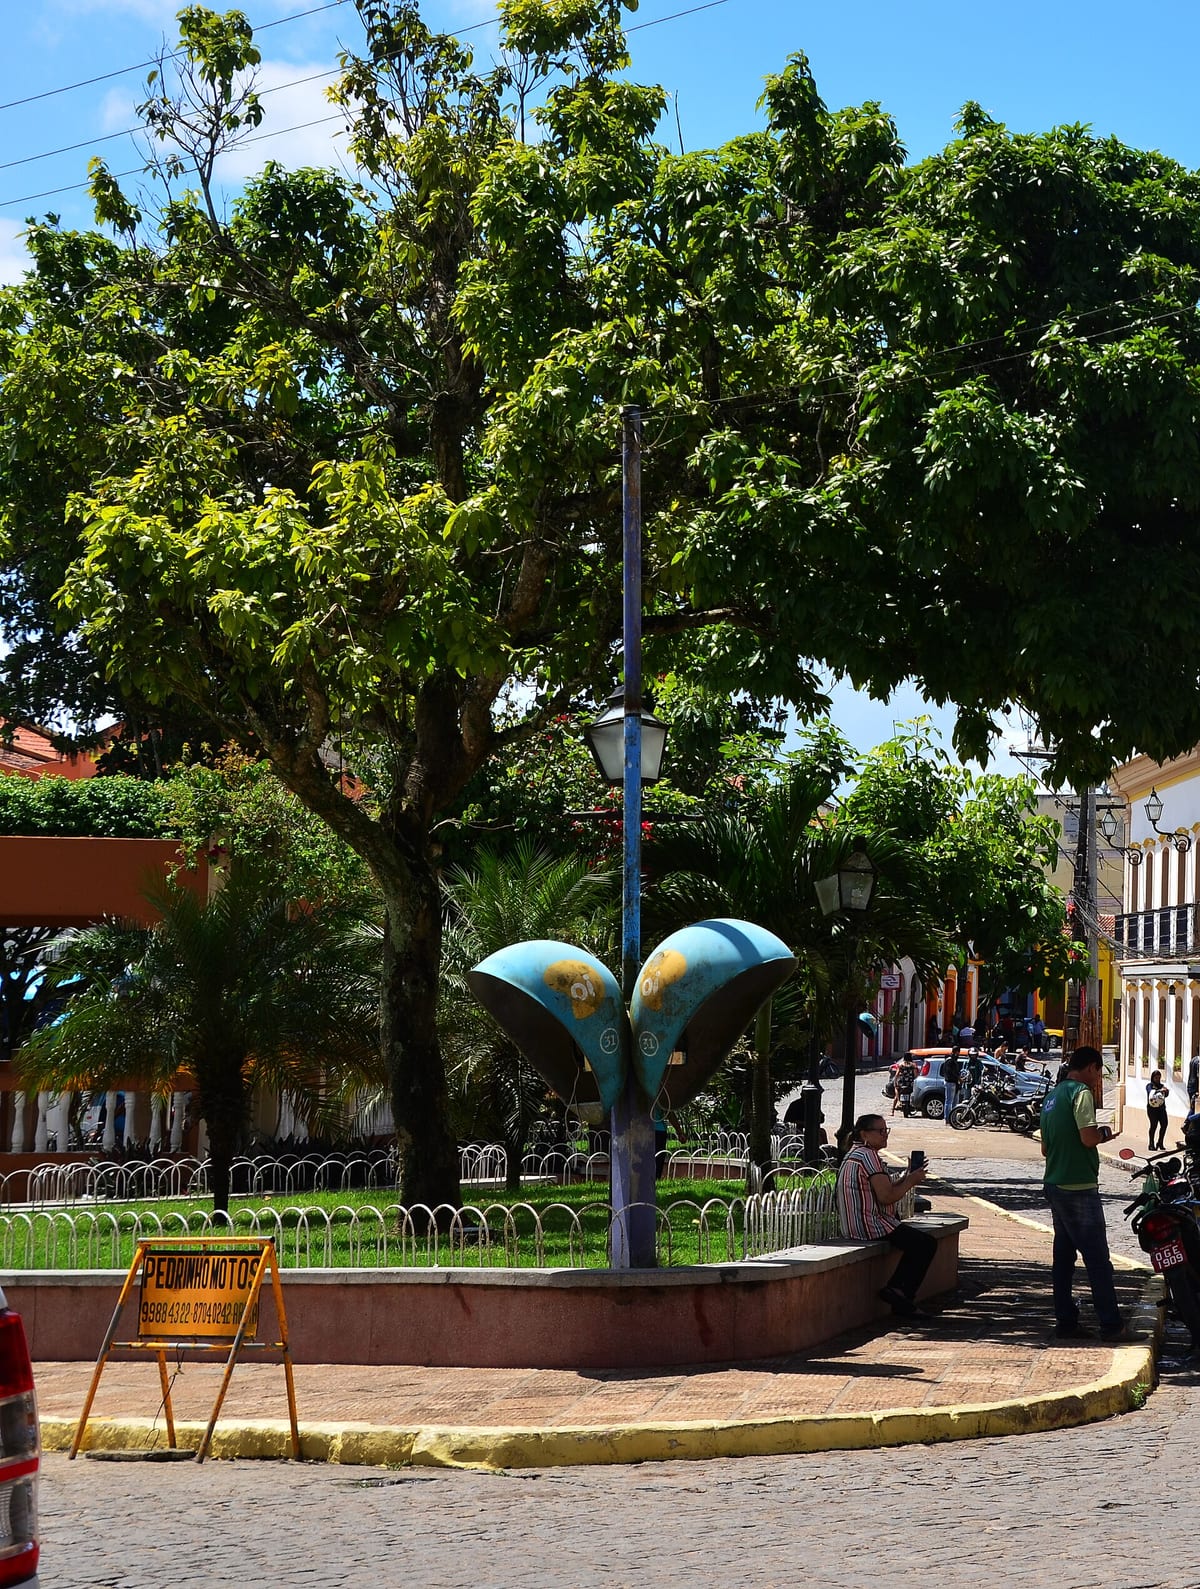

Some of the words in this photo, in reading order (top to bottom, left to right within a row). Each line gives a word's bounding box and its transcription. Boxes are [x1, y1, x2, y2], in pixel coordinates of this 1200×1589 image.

[603, 1034, 617, 1048] 31
[642, 1037, 656, 1050] 31
[1158, 1253, 1184, 1270] 1909
[143, 1256, 209, 1290] PEDRINHO
[209, 1256, 260, 1291] MOTOS
